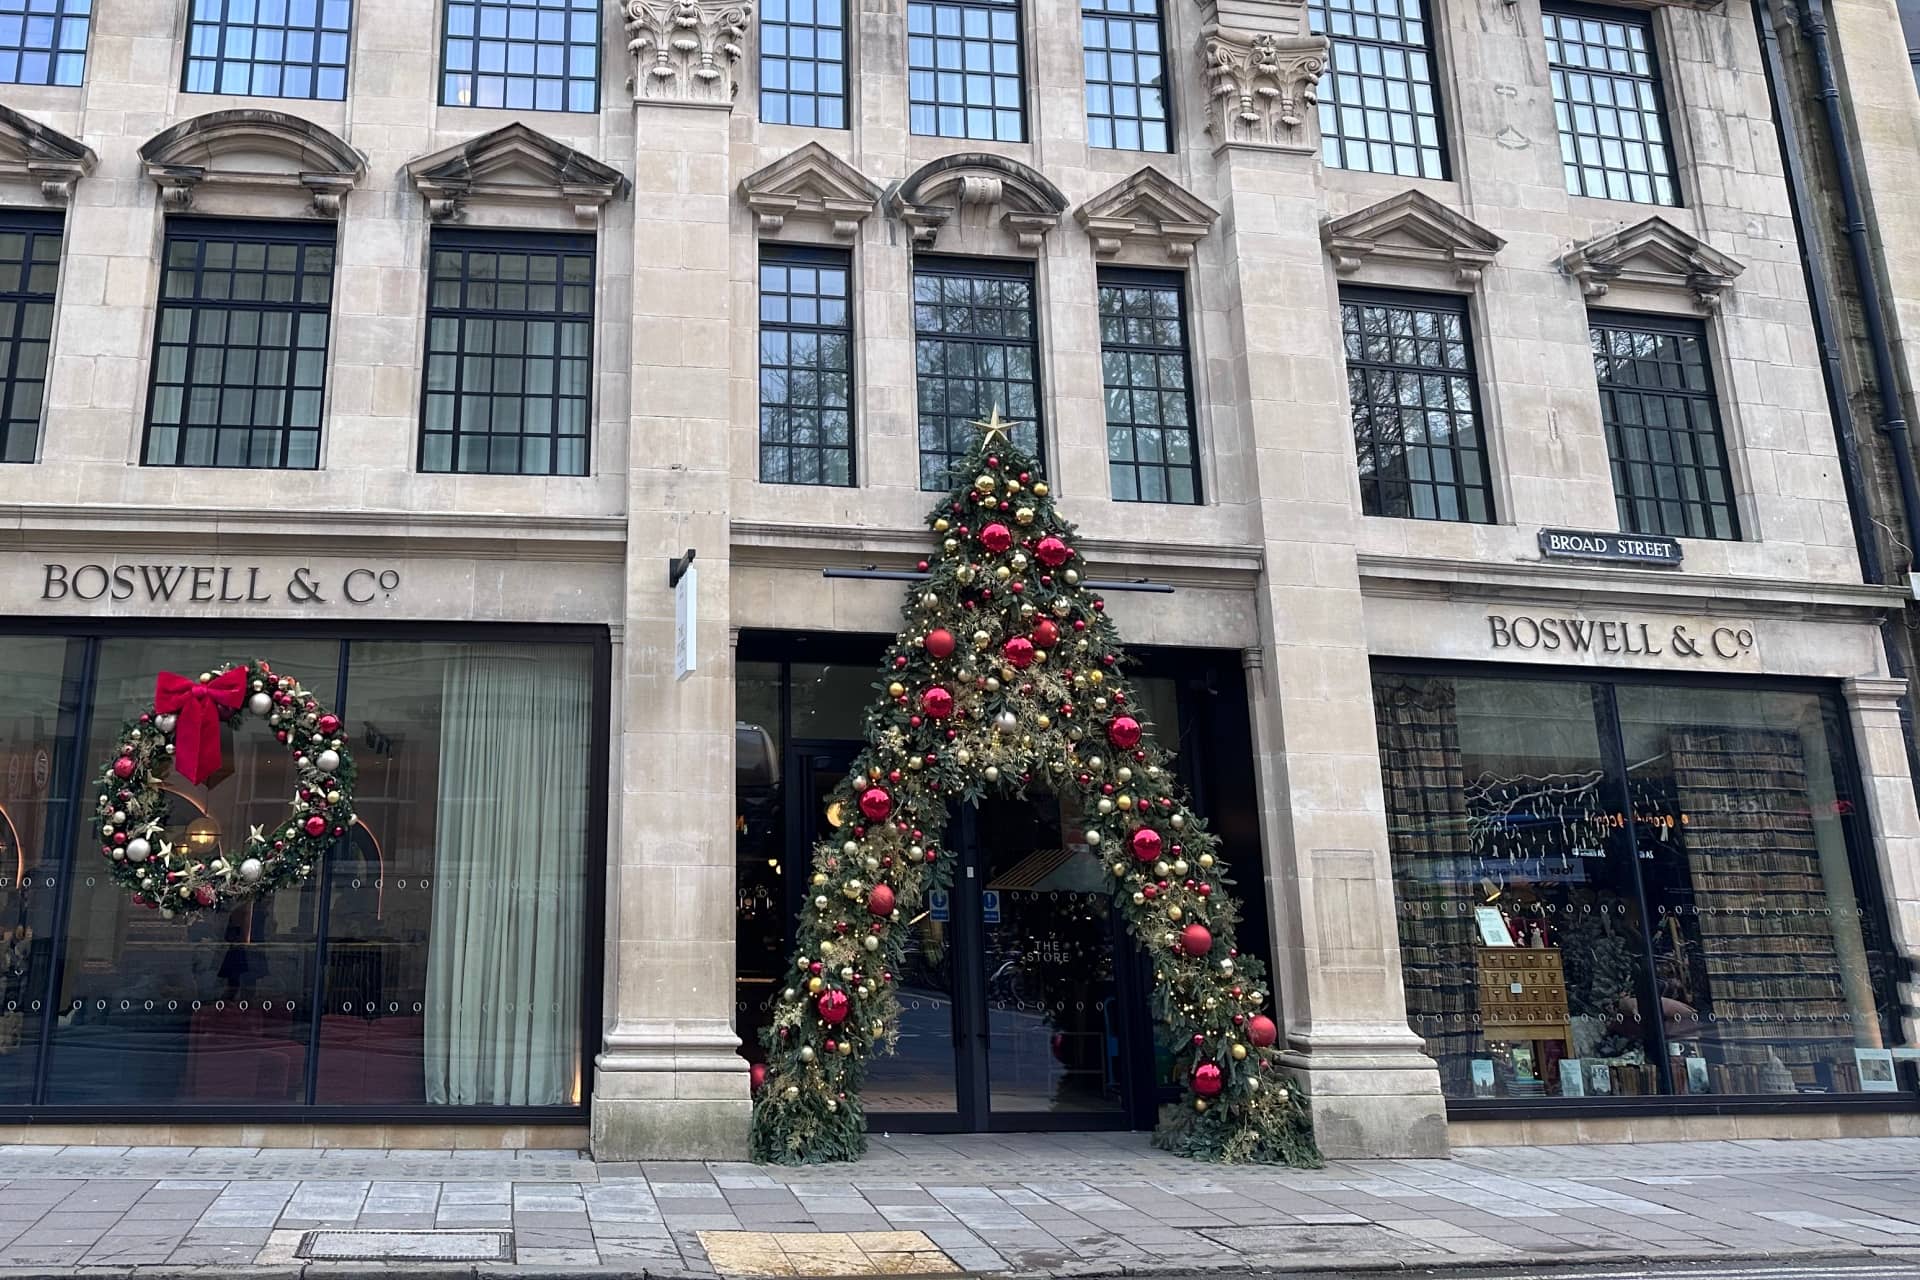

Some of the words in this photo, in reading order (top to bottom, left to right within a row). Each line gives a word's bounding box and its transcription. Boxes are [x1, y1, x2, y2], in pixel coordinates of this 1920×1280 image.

[1550, 535, 1607, 553] BROAD
[1618, 540, 1671, 558] STREET
[40, 563, 272, 603] BOSWELL
[286, 567, 327, 604] &
[1488, 615, 1662, 656] BOSWELL
[1672, 624, 1704, 657] &
[1027, 951, 1070, 962] STORE
[1034, 940, 1060, 951] THE
